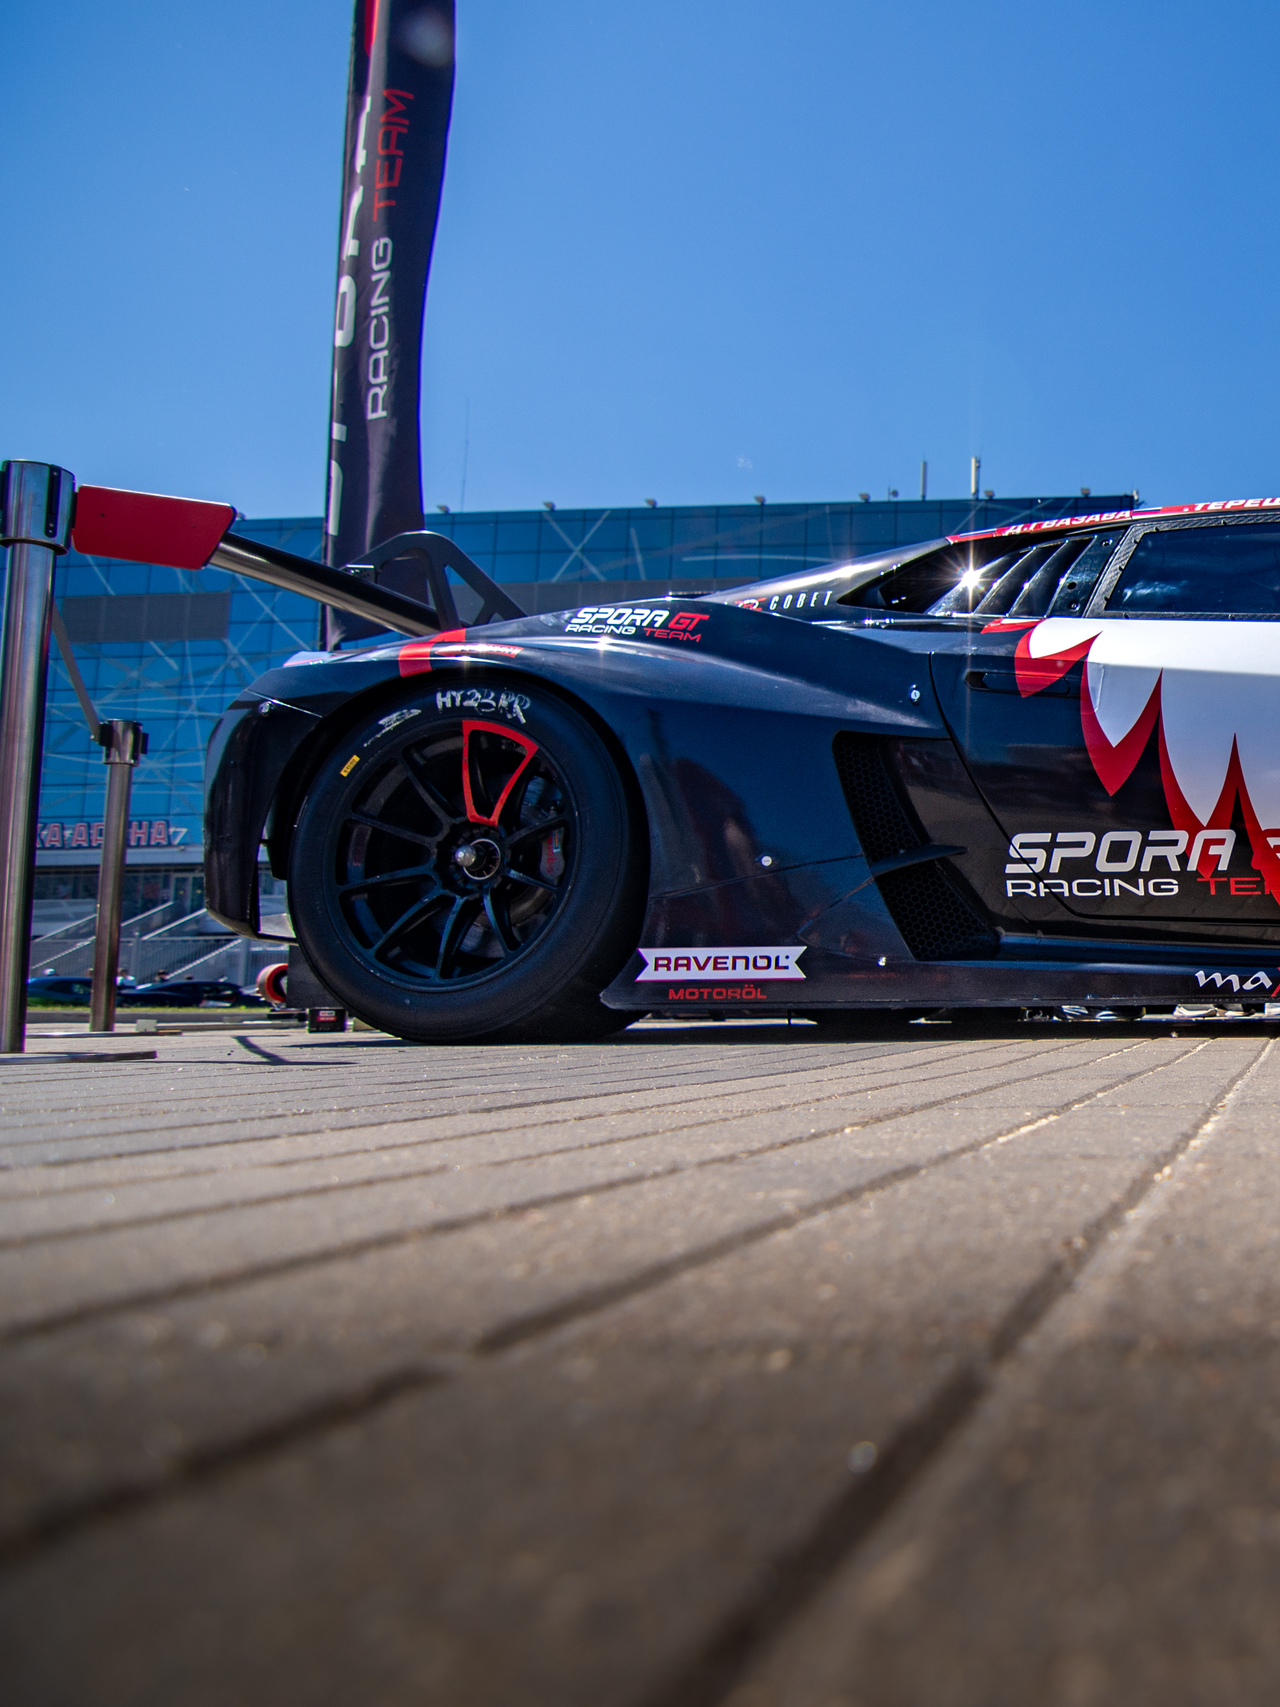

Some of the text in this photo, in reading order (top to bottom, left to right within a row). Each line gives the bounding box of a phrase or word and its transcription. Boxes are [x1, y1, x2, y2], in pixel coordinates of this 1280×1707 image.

[366, 88, 415, 421] RACING TEAM
[570, 607, 710, 632] SPORA GT
[564, 623, 702, 643] RACING TEAM
[1004, 828, 1237, 874] SPORA
[1004, 877, 1180, 898] RACING
[653, 954, 790, 972] RAVENOL
[668, 984, 767, 1000] MOTORÖL
